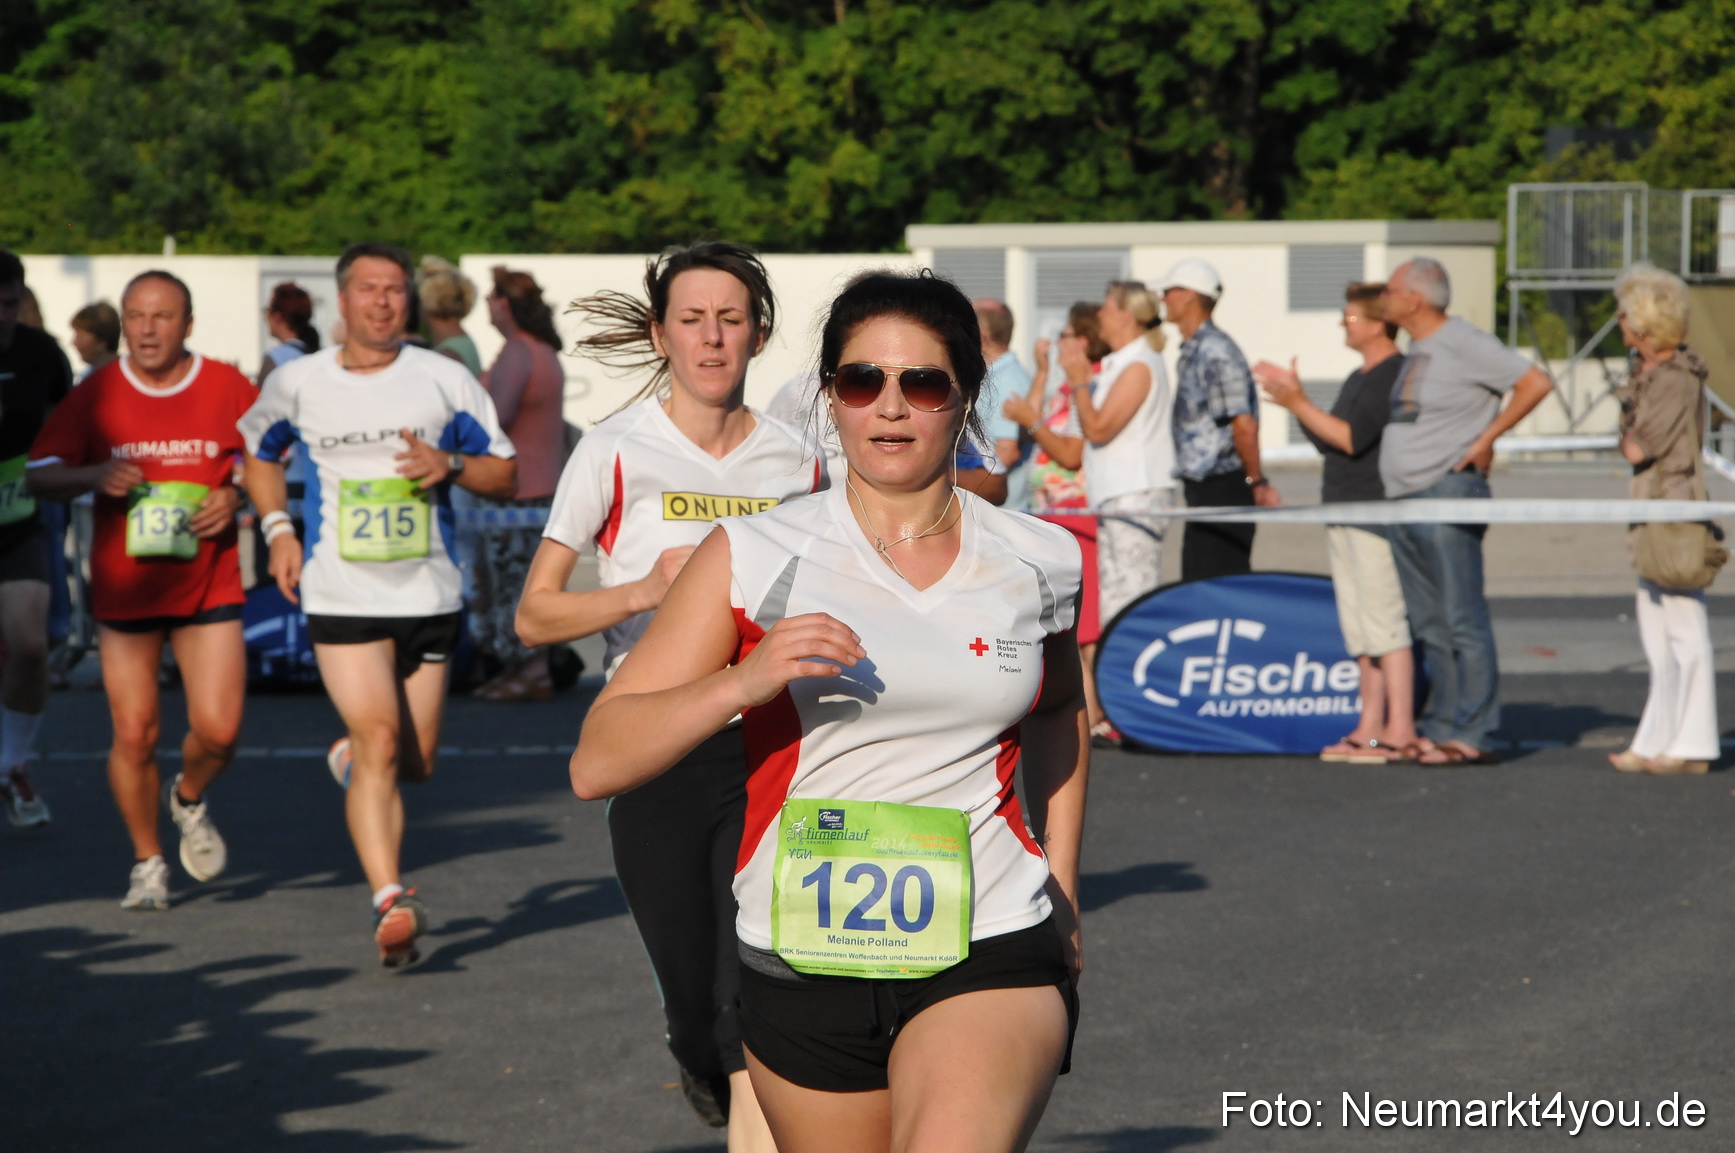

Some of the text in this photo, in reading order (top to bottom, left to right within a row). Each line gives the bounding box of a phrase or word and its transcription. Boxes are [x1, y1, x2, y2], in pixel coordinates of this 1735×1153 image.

[111, 439, 203, 458] NEUMARKT
[670, 496, 768, 517] ONLINE
[352, 505, 415, 538] 215
[996, 638, 1032, 646] Bayerisches
[998, 651, 1018, 659] Kreuz
[999, 664, 1022, 673] Melanie
[1179, 652, 1361, 696] Fische
[806, 827, 870, 841] firmenlauf
[802, 861, 935, 933] 120
[827, 934, 908, 947] Melanie Polland
[780, 947, 794, 955] BRK
[796, 949, 847, 958] Seniorenzentren
[849, 952, 888, 961] Woffenbach
